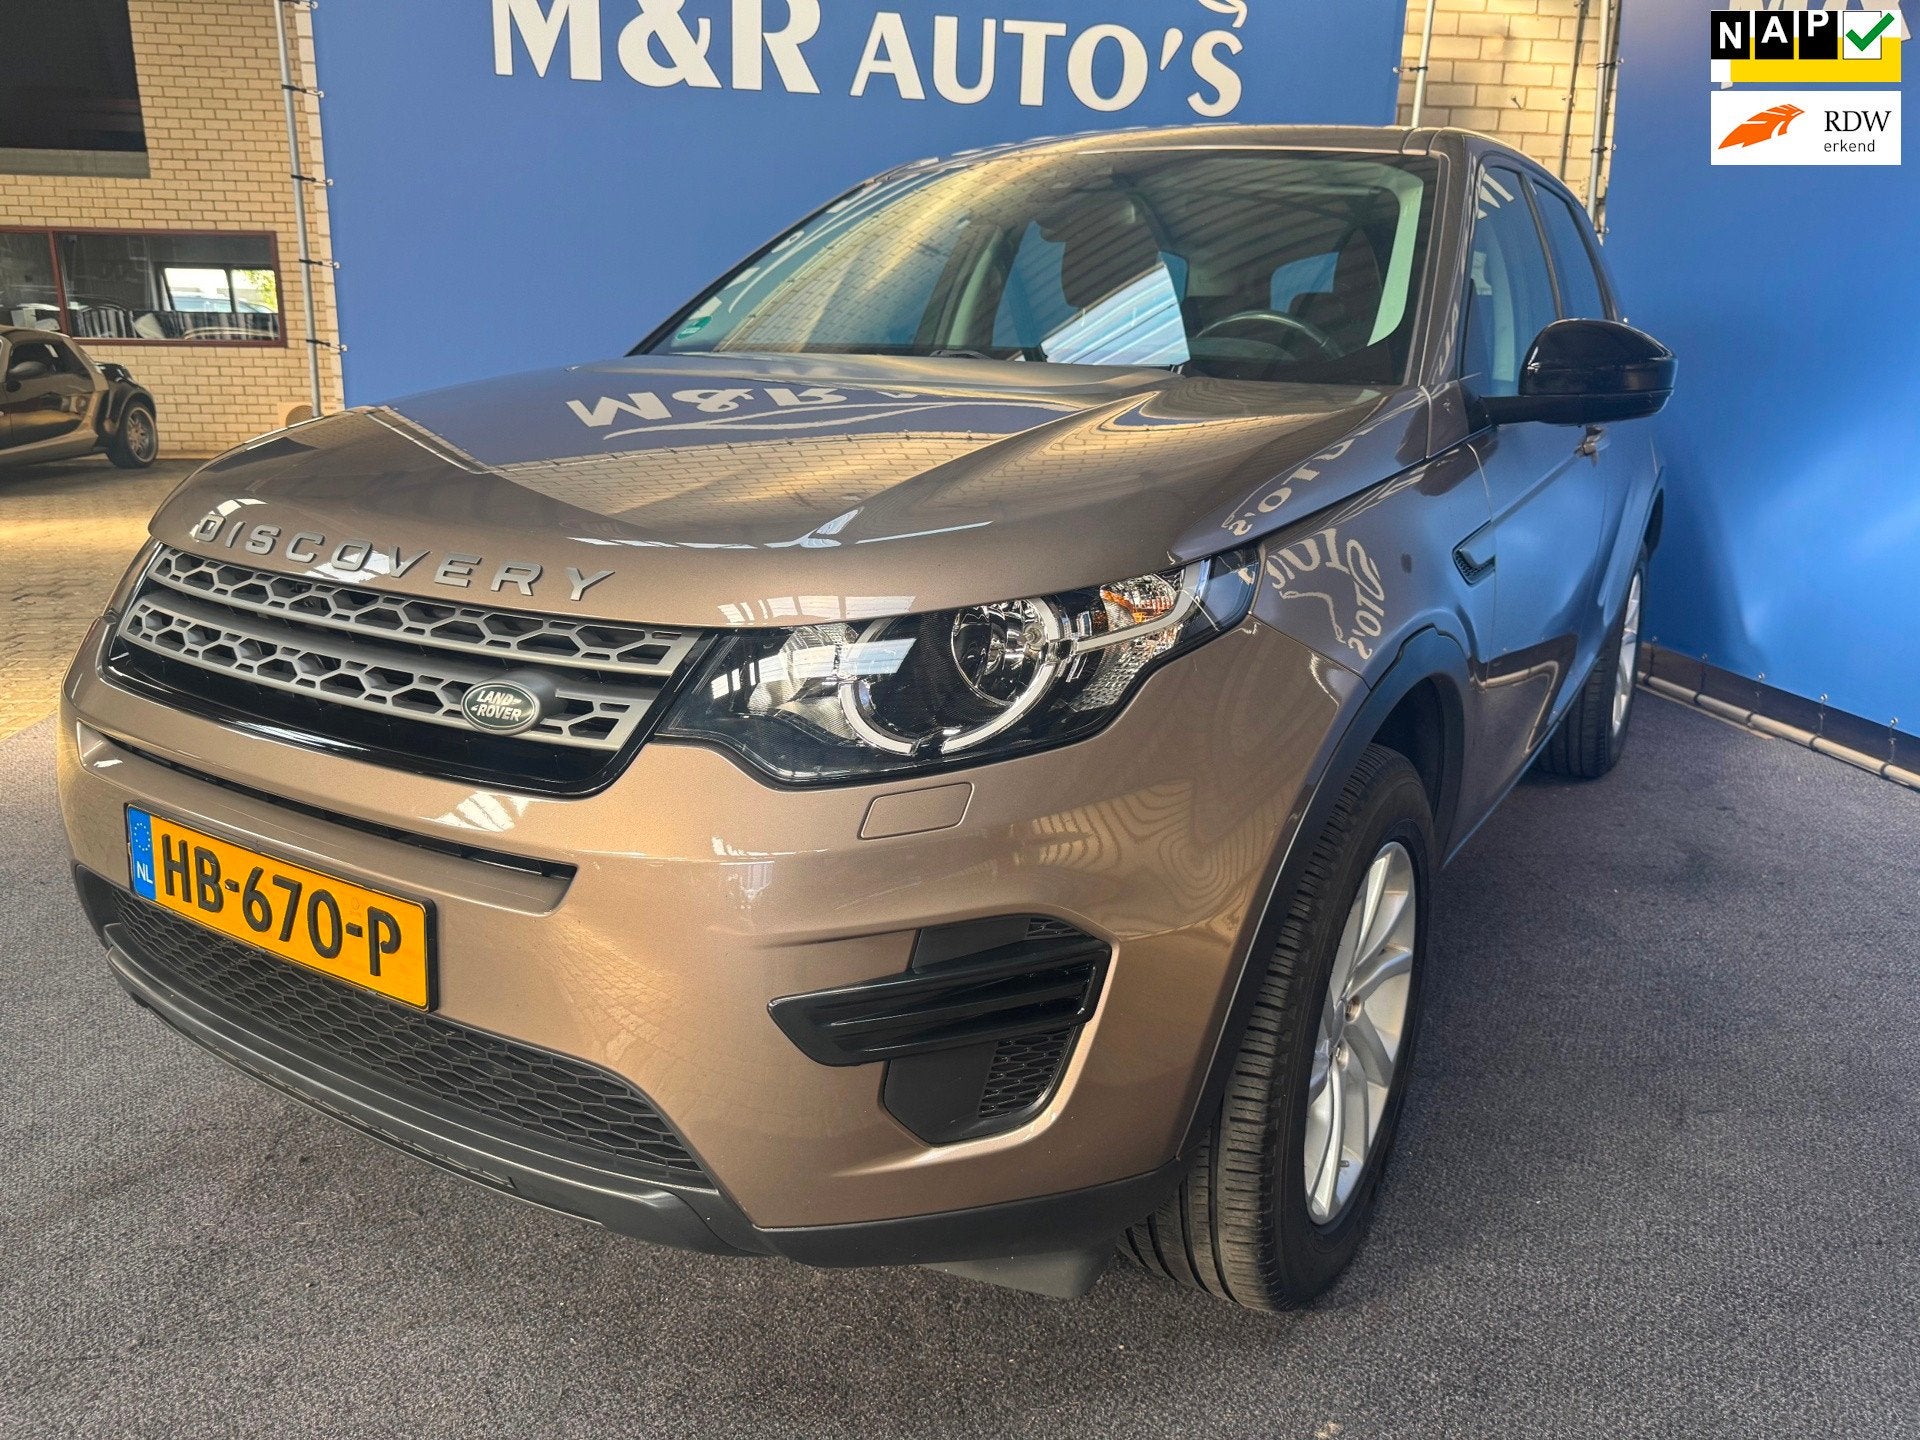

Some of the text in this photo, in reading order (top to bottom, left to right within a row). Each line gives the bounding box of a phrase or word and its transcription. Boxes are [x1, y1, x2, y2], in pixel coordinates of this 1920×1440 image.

[493, 0, 1243, 117] M&R AUTO'S
[195, 513, 616, 601] DISCOVERY
[476, 704, 522, 721] ROVER
[136, 860, 154, 884] NL
[161, 833, 402, 977] HB-670-P
